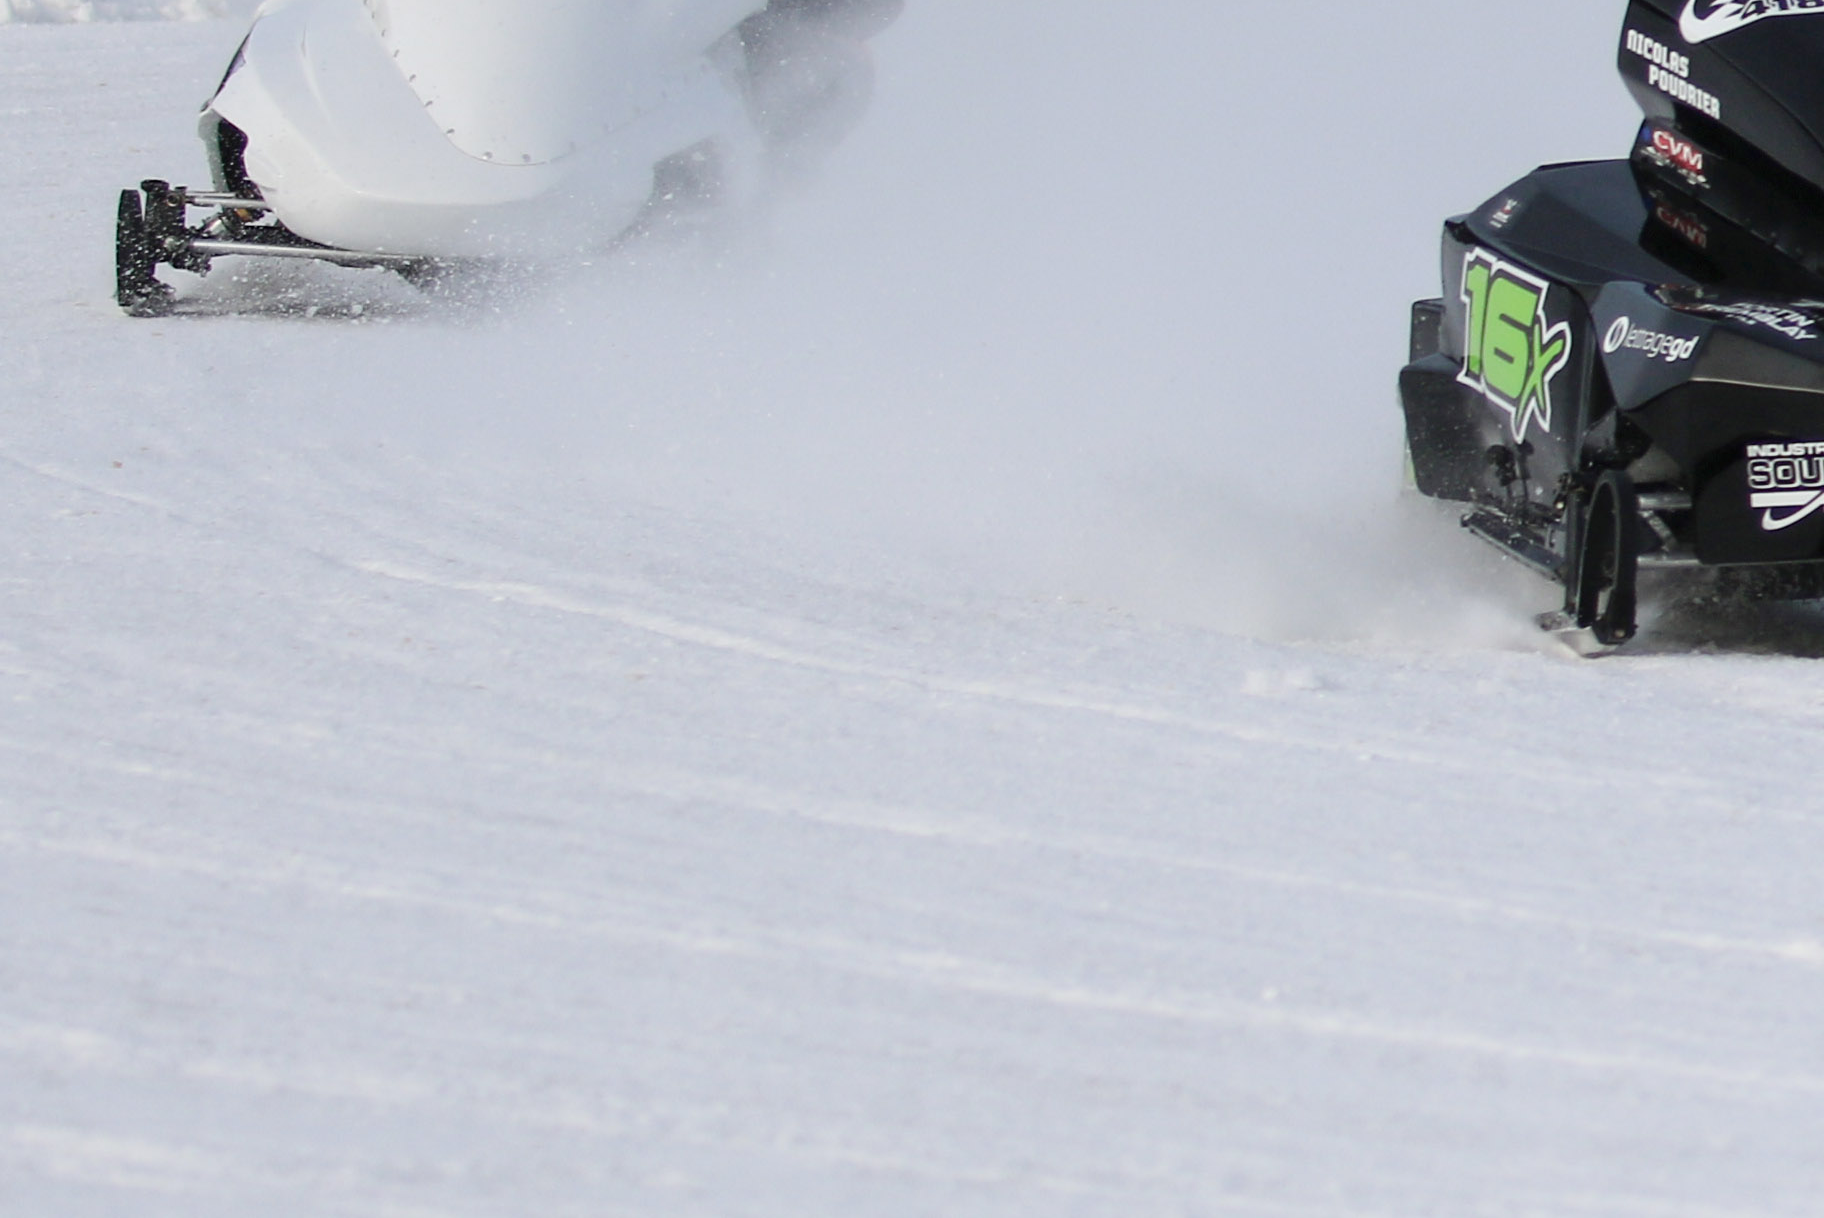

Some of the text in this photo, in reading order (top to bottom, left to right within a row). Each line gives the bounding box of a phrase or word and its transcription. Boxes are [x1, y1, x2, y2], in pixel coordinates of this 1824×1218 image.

[1626, 28, 1690, 79] NICOLAS
[1648, 64, 1721, 121] POUDRIER
[1652, 130, 1703, 171] CVM
